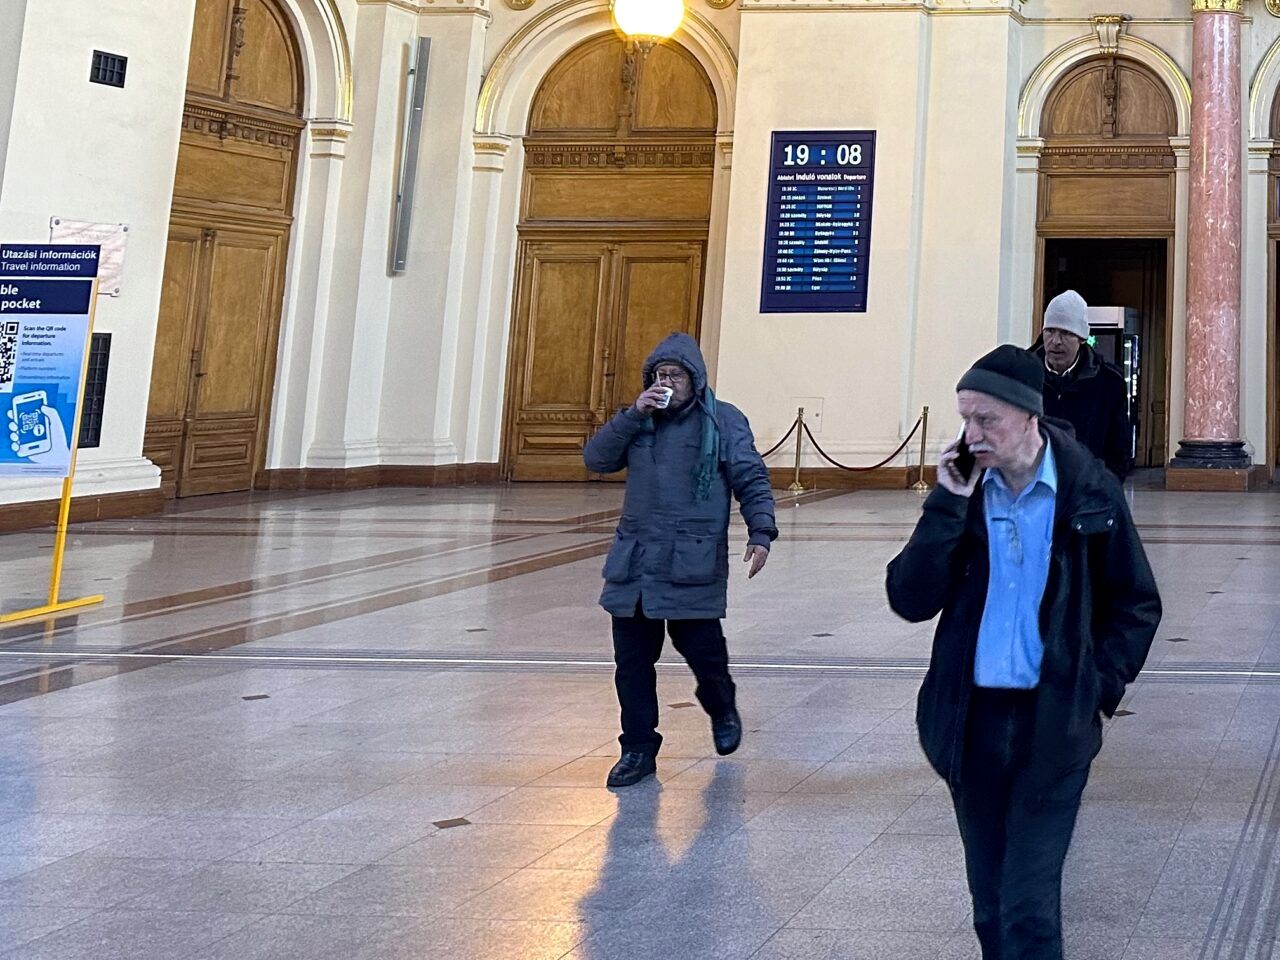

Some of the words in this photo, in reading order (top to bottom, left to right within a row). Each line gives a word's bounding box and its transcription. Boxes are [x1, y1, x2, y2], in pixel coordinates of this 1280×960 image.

[784, 144, 809, 165] 19
[837, 144, 861, 165] 08
[2, 250, 37, 259] Utazási
[40, 250, 96, 259] információk
[1, 262, 29, 271] Travel
[31, 262, 80, 271] information
[1, 300, 41, 311] pocket
